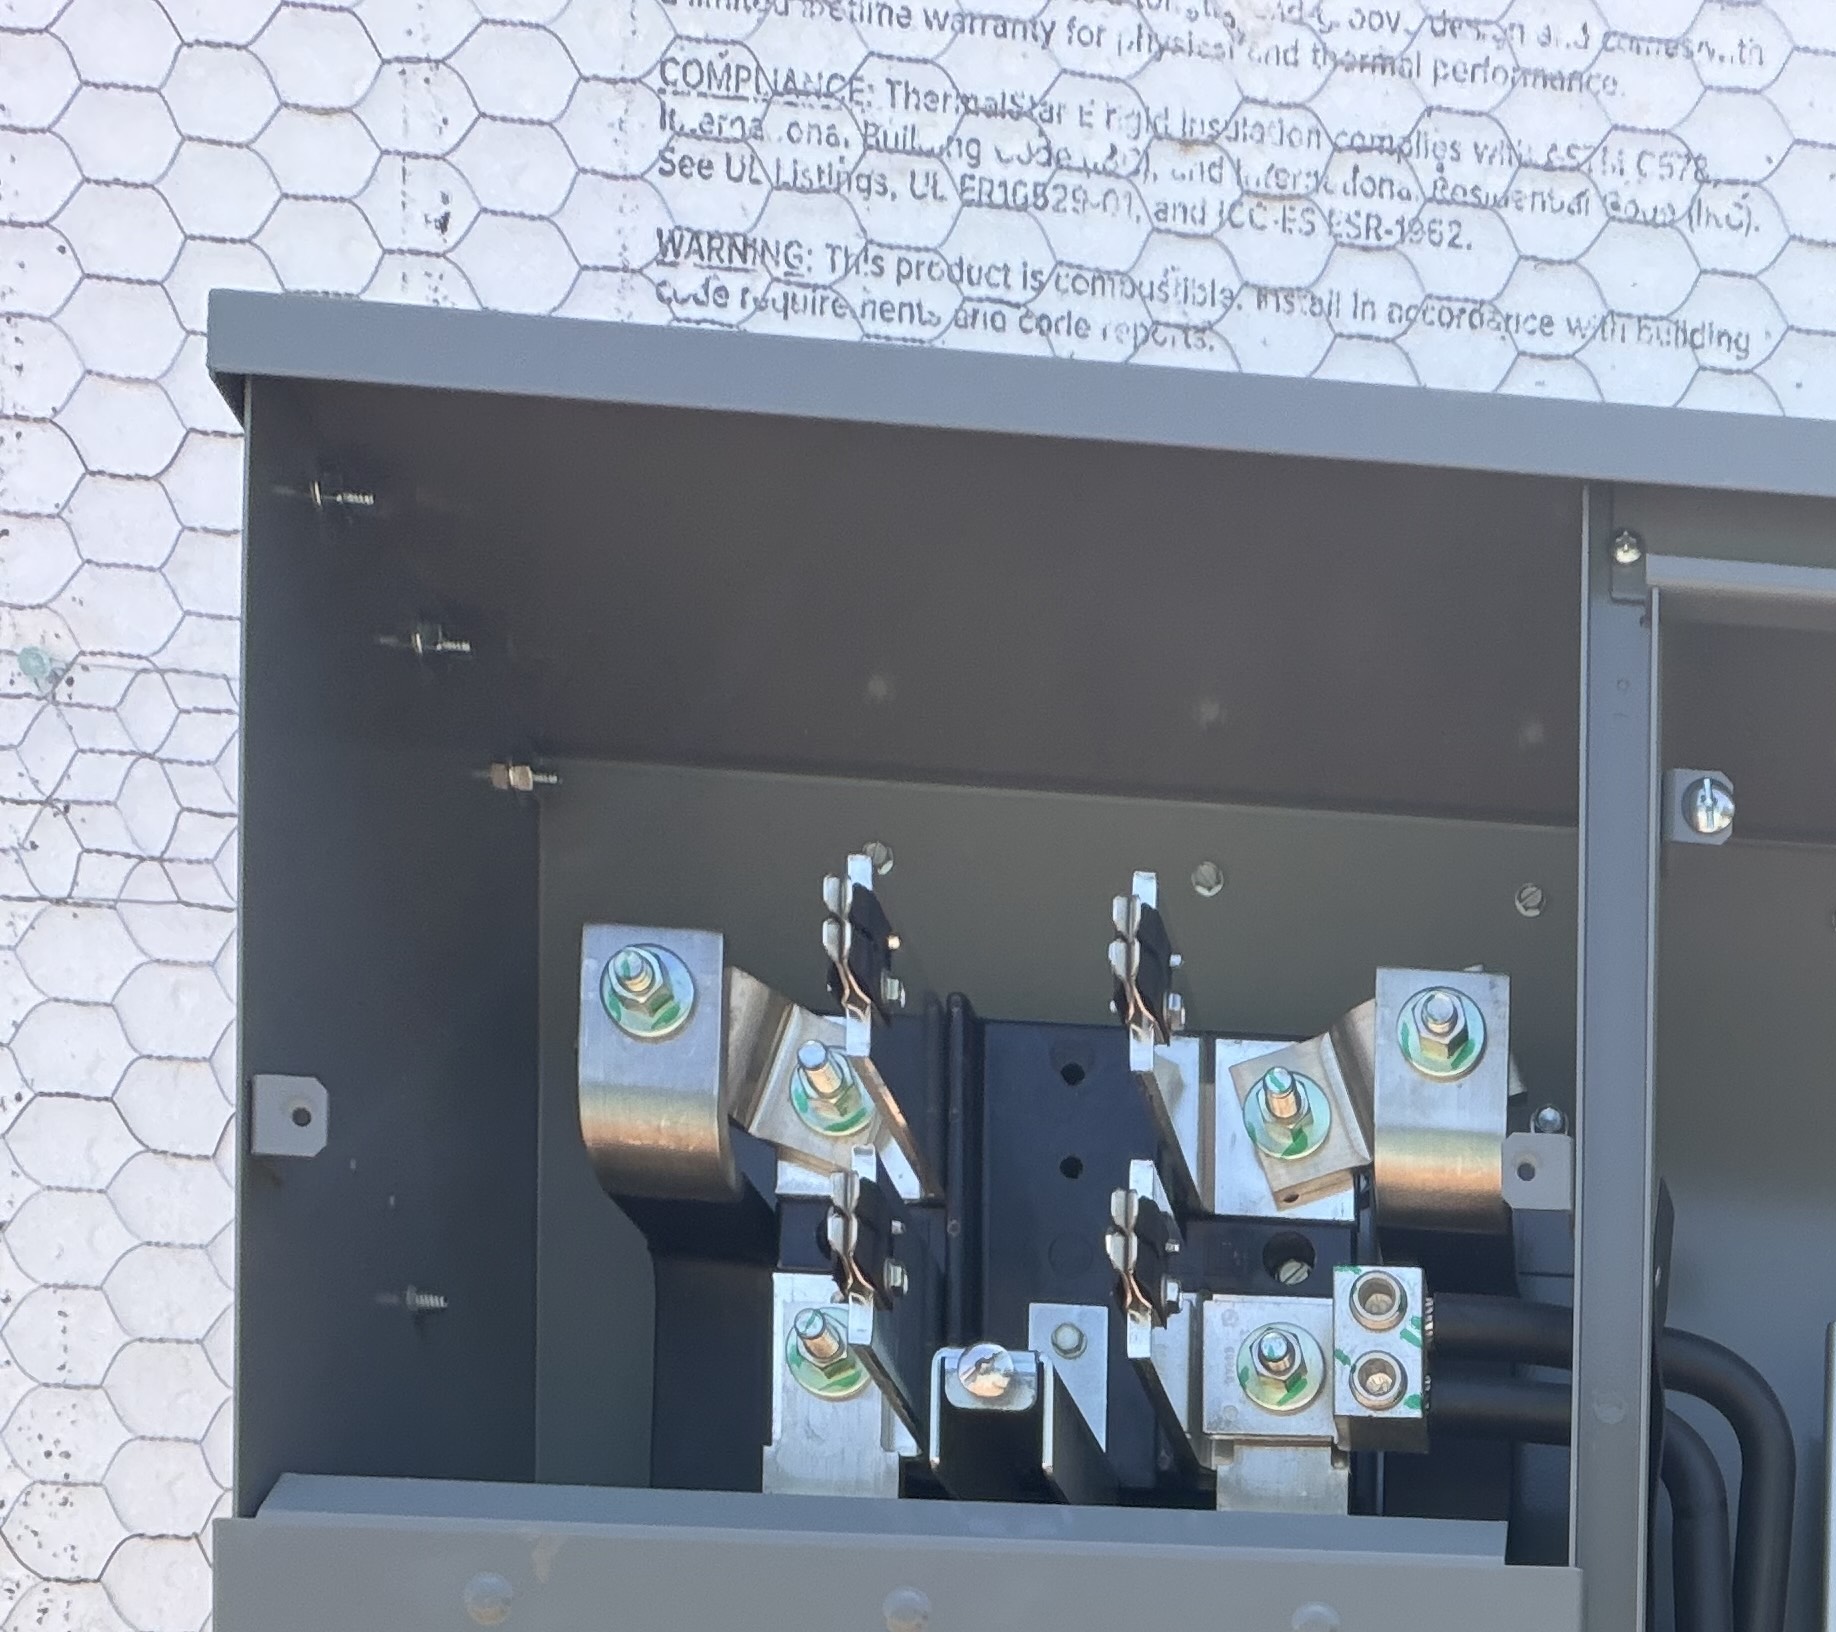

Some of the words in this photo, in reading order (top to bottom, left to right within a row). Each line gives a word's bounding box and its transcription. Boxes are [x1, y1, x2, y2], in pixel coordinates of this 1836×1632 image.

[923, 7, 1056, 50] warranty
[1066, 15, 1107, 48] for
[1334, 129, 1462, 165] complies
[658, 145, 714, 180] See
[725, 152, 763, 185] UL
[775, 156, 898, 202] Listings,
[909, 168, 948, 201] UL
[1154, 200, 1206, 226] and
[655, 227, 813, 273] WARNING:
[825, 243, 885, 278] This
[896, 252, 1011, 289] product
[1022, 261, 1046, 294] is
